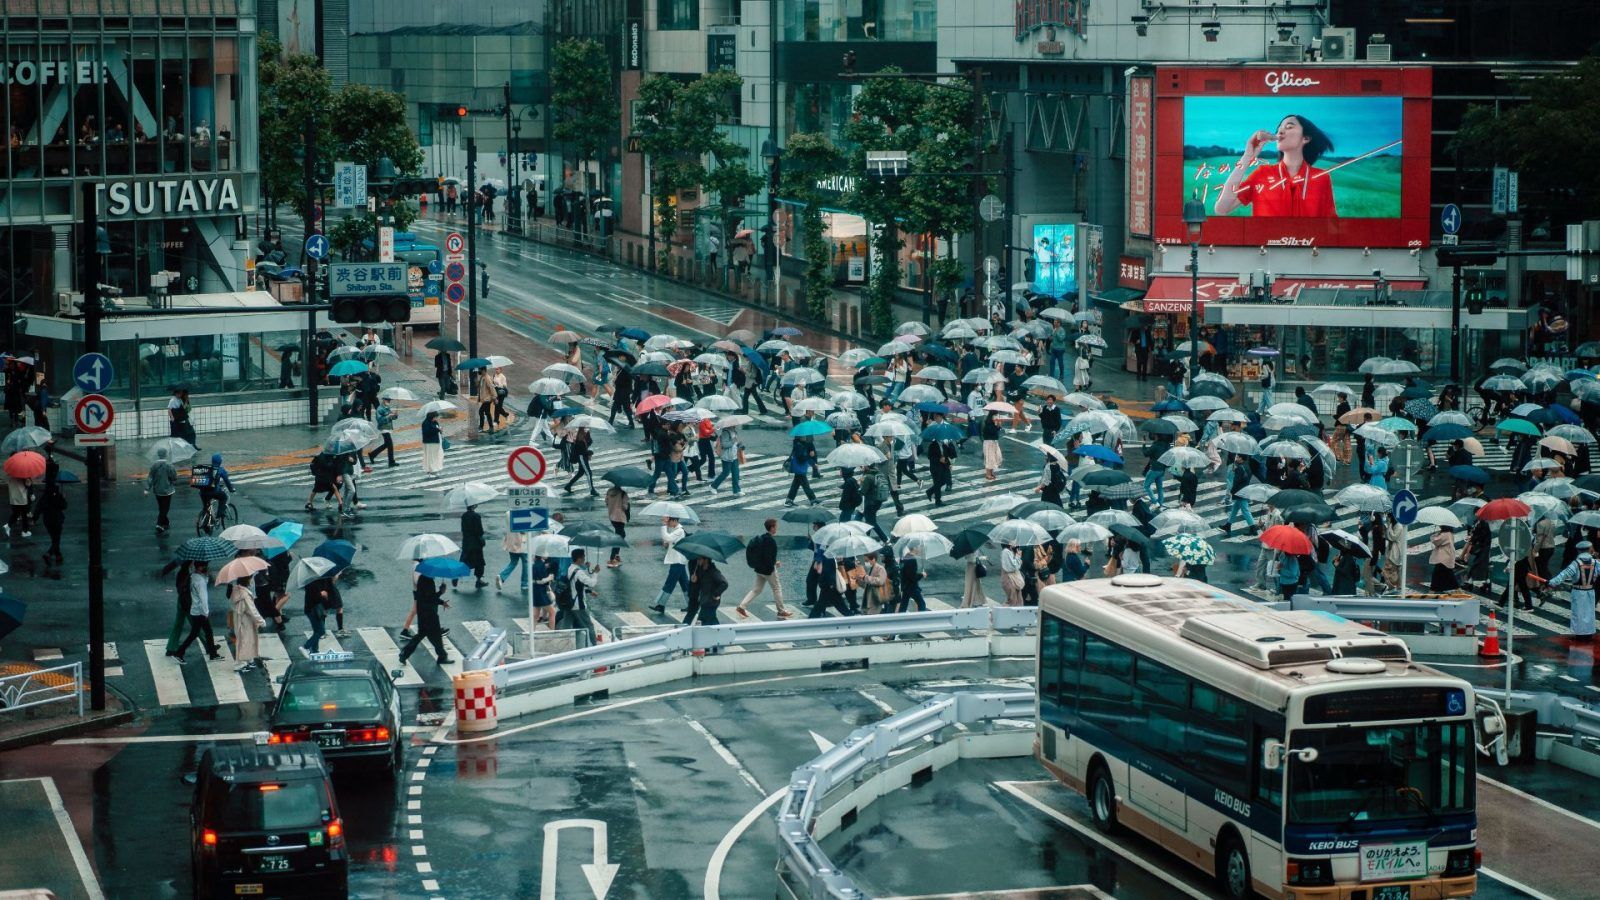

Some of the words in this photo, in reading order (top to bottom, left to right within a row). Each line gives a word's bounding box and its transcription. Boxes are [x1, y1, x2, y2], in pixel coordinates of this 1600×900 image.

[0, 61, 108, 86] COFFEE
[1264, 71, 1320, 92] Glico
[1134, 102, 1146, 229] 天津甘栗
[816, 175, 855, 192] AMERICAN
[336, 267, 402, 282] 渋谷駅前
[1120, 262, 1145, 281] 天津甘栗
[346, 283, 377, 292] Shibuya
[379, 283, 395, 291] Sta.
[1148, 302, 1193, 312] SANZENR
[1214, 788, 1233, 809] KEIO
[1233, 798, 1251, 818] BUS
[1309, 841, 1335, 850] KEIO
[1335, 839, 1359, 849] BUS
